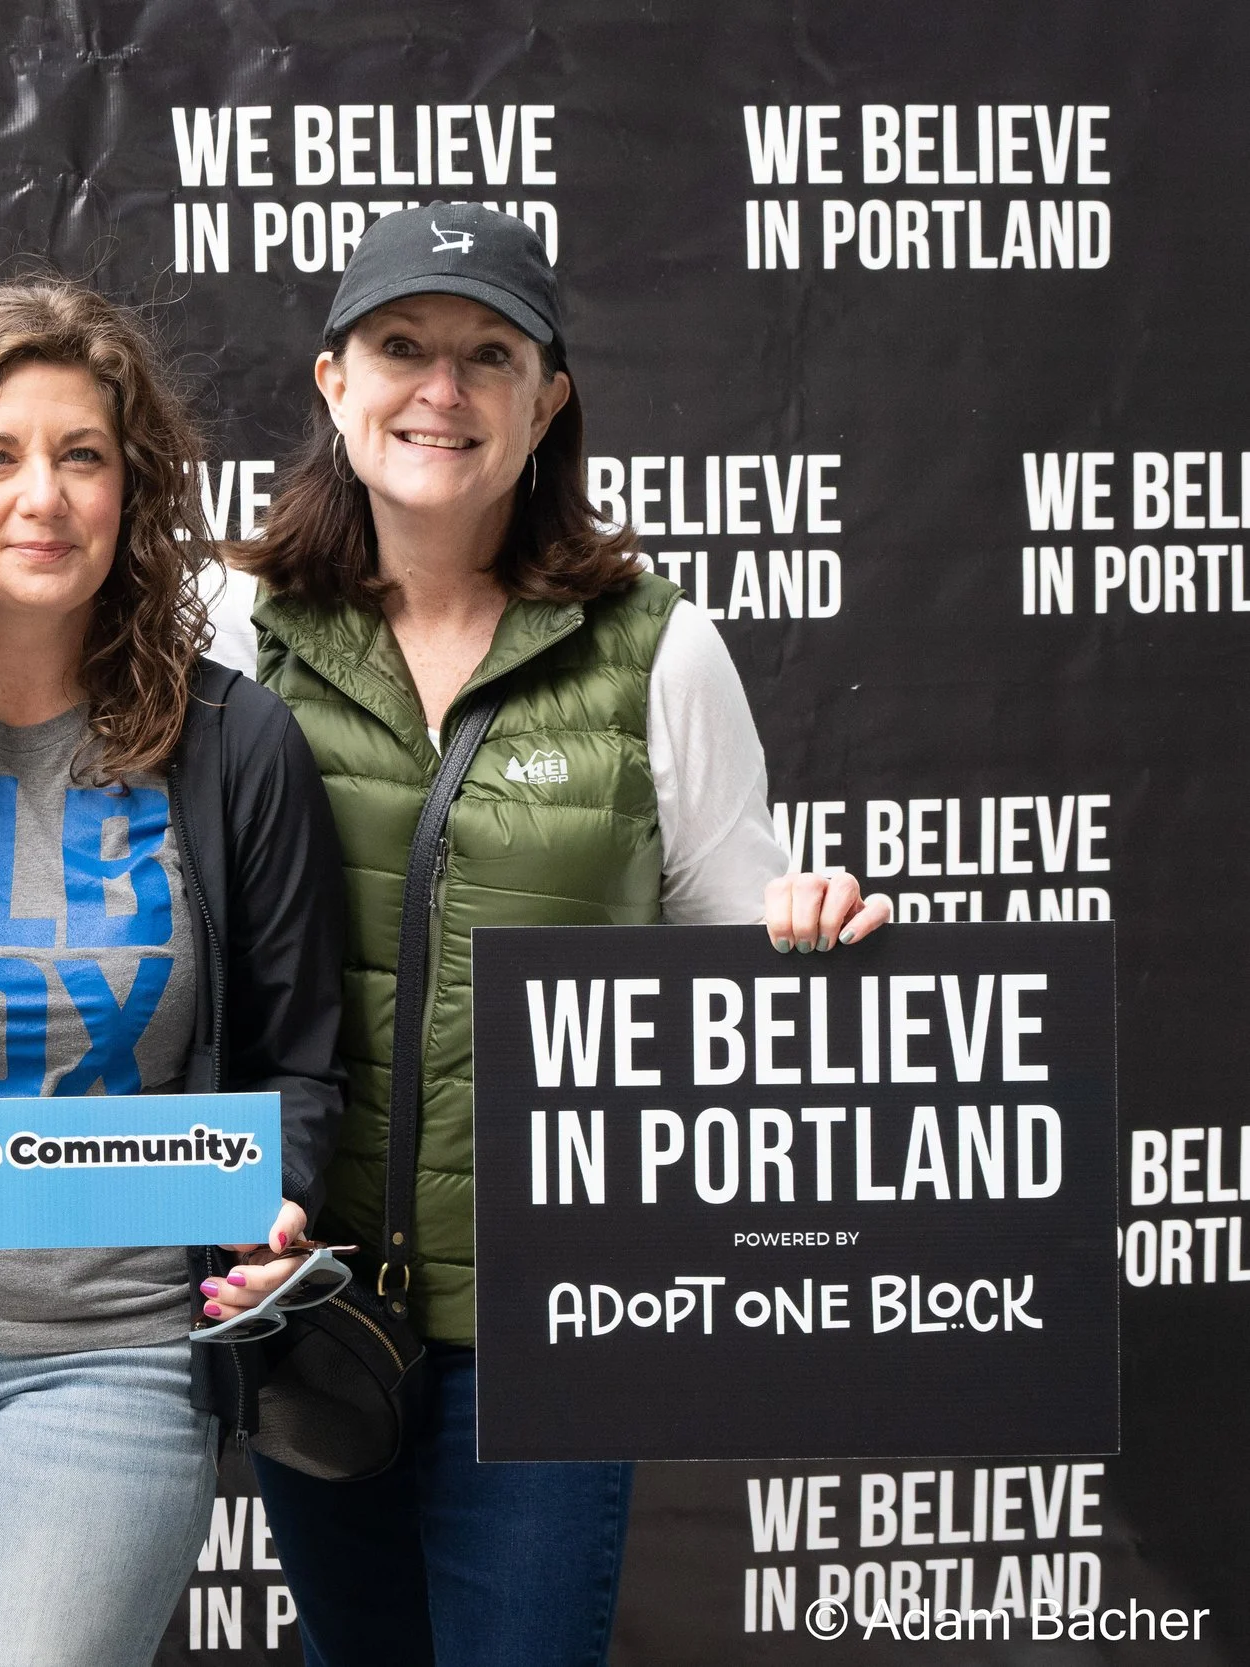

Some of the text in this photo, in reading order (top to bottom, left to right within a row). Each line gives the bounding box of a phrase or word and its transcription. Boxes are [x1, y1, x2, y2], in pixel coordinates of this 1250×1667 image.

[172, 105, 556, 186] WE BELIEVE
[743, 105, 1110, 184] WE BELIEVE
[173, 203, 229, 273] IN
[746, 199, 1110, 270] IN PORTLAND
[587, 454, 842, 536] BELIEVE
[1023, 452, 1250, 530] WE BELI
[622, 550, 842, 620] TLAND
[1023, 544, 1250, 615] IN PORTL
[527, 758, 568, 778] REI
[772, 795, 1111, 880] WE BELIEVE
[526, 974, 1048, 1087] WE BELIEVE
[10, 1129, 257, 1168] Community.
[531, 1105, 1062, 1204] IN PORTLAND
[1131, 1125, 1250, 1206] BELI
[734, 1231, 860, 1247] POWERED BY
[1118, 1216, 1250, 1288] ORTL
[549, 1274, 1043, 1345] ADOPT ONE BLOCK
[197, 1497, 282, 1571] WE
[747, 1463, 1104, 1552] WE BELIEVE
[190, 1586, 242, 1650] IN
[744, 1552, 1101, 1632] IN PORTLAND
